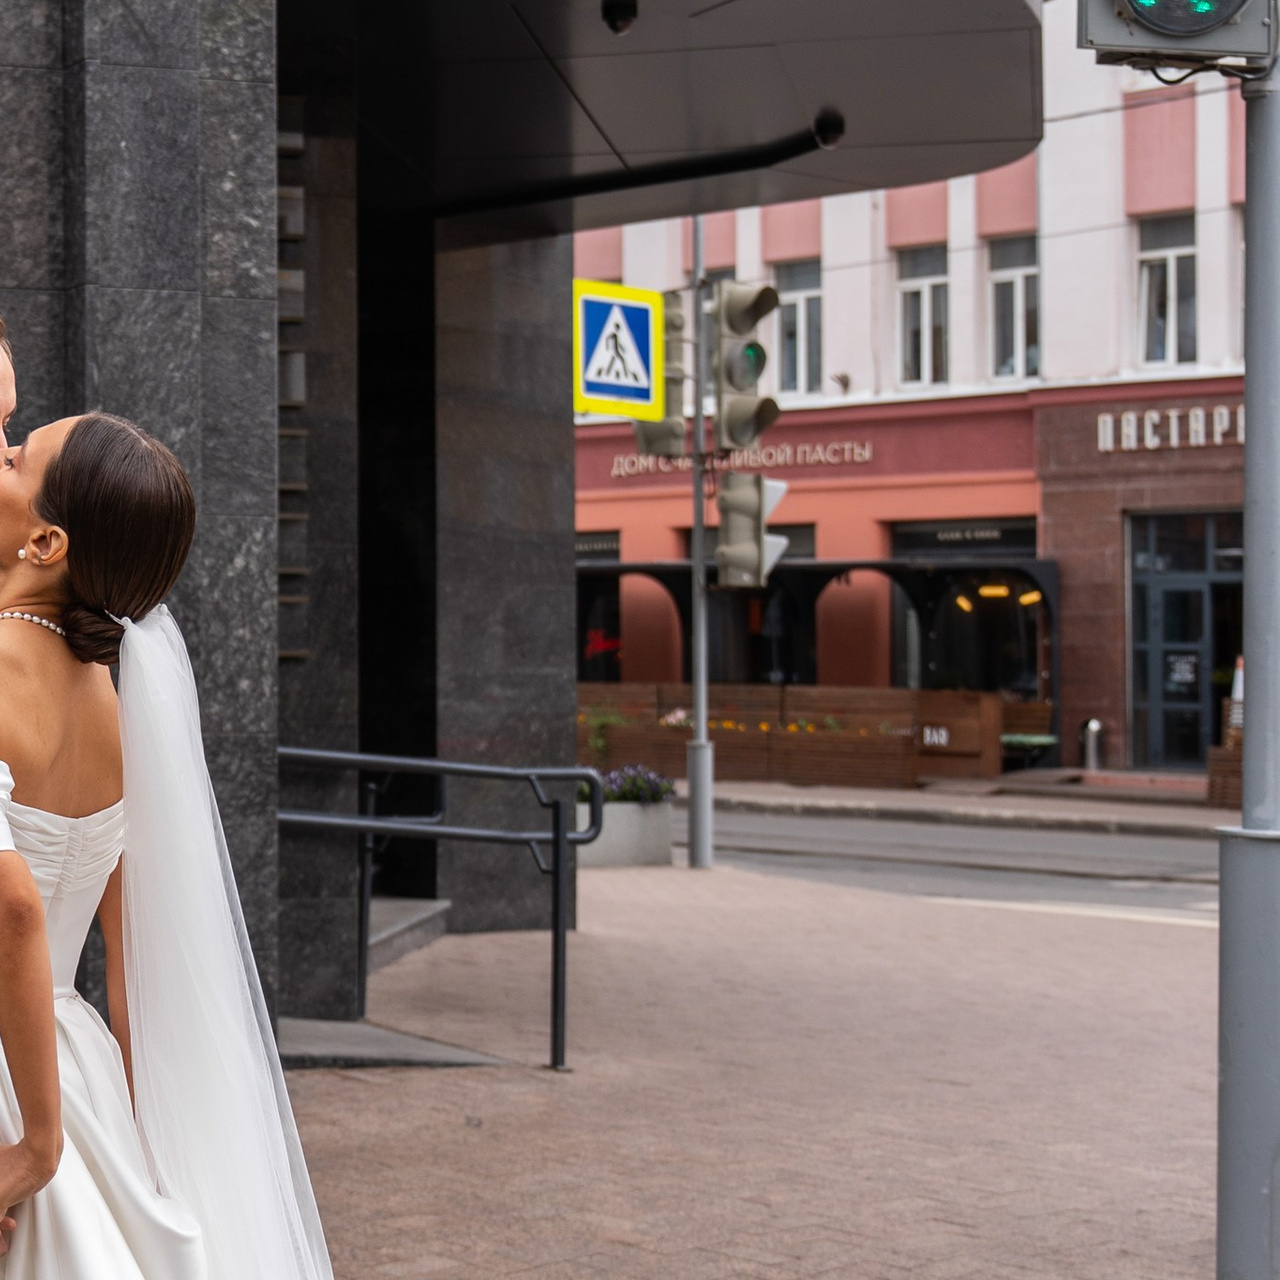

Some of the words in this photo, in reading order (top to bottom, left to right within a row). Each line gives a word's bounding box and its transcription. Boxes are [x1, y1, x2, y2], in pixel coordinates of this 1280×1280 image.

[611, 454, 656, 477] ДОМ
[658, 443, 794, 473] СЧАЛИВОЙ
[796, 441, 874, 465] ПАСТЫ
